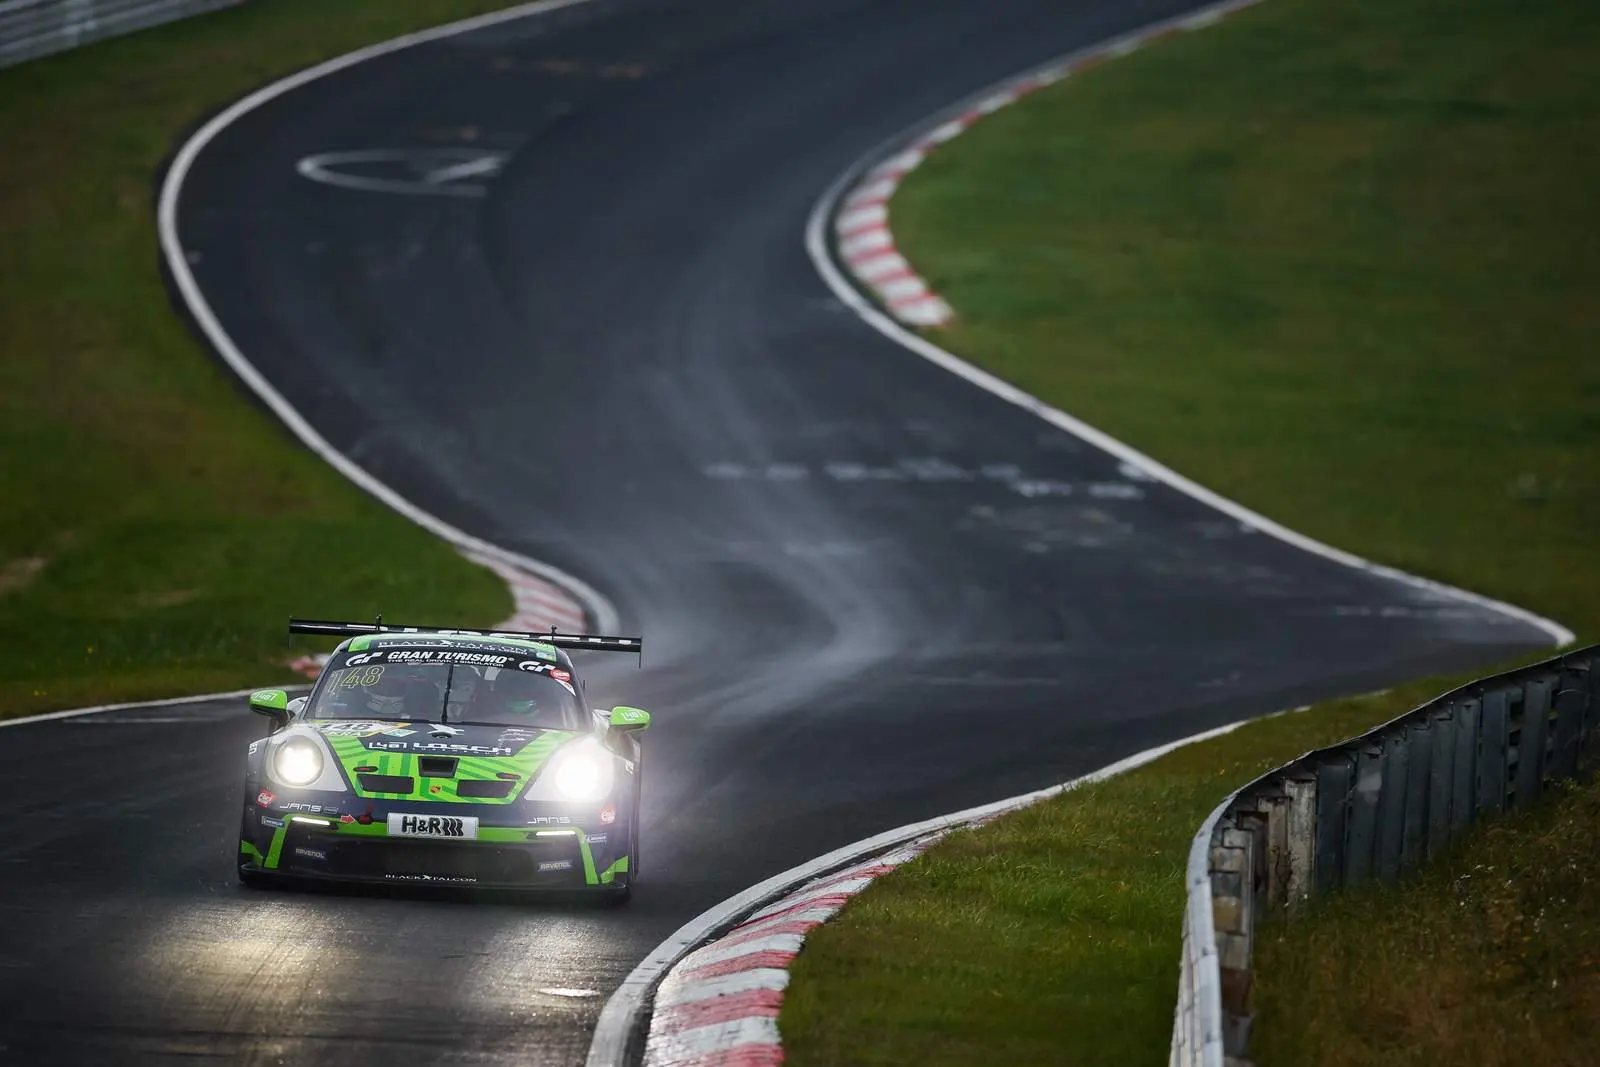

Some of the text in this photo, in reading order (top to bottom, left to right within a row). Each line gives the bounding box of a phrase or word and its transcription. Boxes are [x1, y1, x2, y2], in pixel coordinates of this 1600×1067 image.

[387, 651, 508, 663] GRAN TURISMO
[328, 665, 385, 693] 148
[402, 816, 441, 834] H&R
[296, 848, 325, 859] RAVENOL
